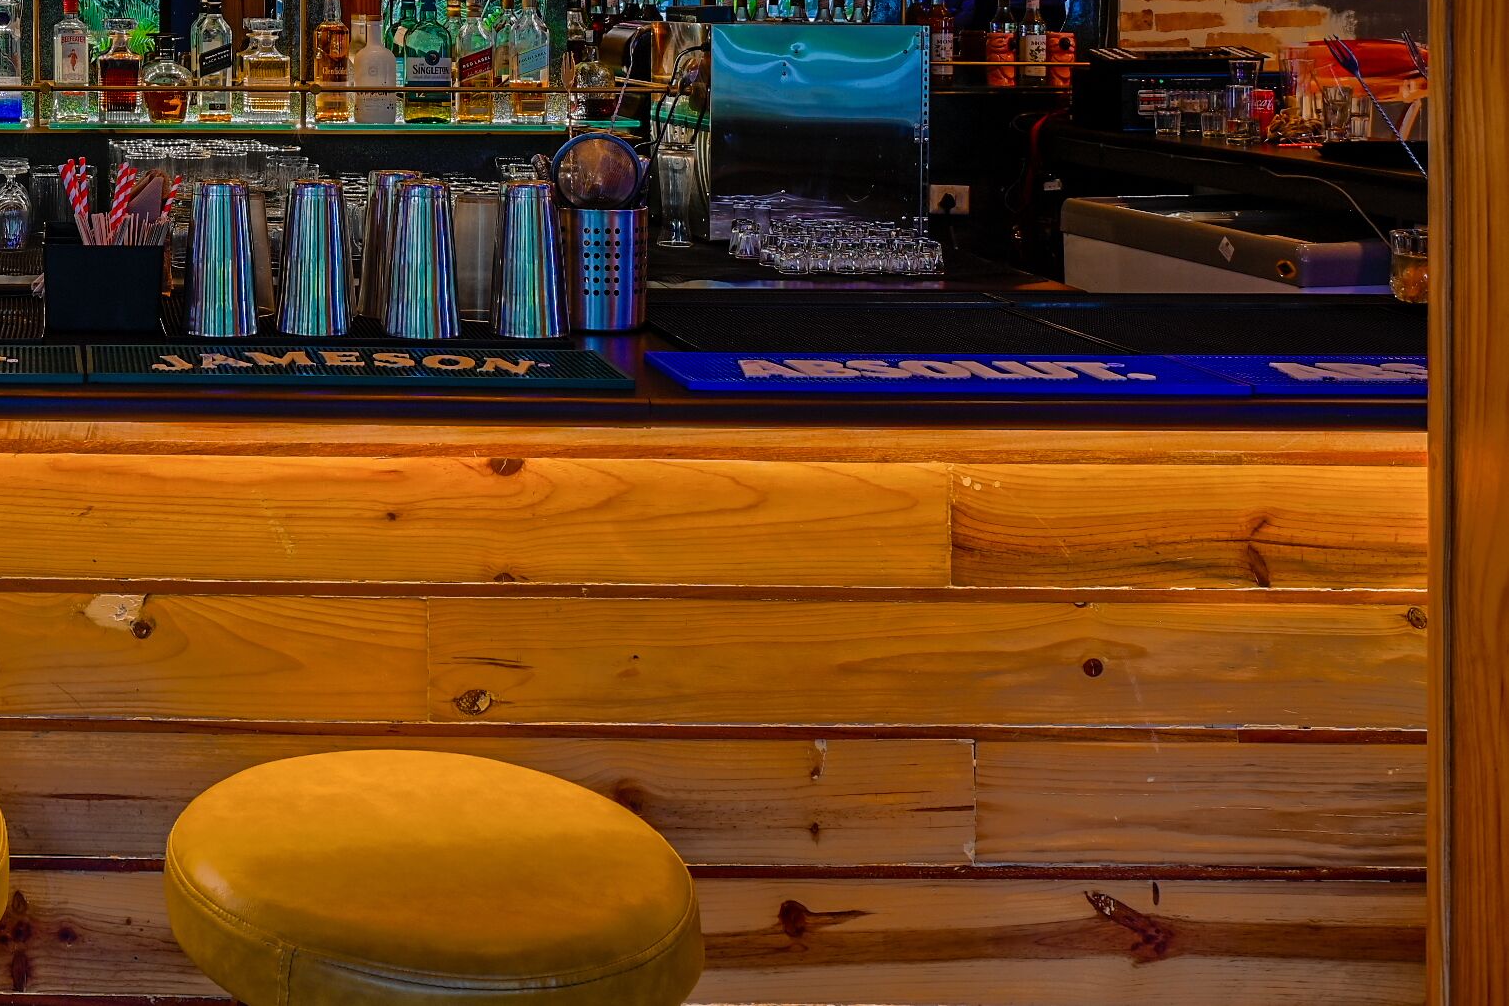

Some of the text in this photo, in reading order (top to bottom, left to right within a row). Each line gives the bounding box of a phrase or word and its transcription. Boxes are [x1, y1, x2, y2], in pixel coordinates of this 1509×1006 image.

[474, 55, 491, 64] LABEL
[412, 65, 449, 74] SINGLETON
[152, 350, 539, 375] JAMESON
